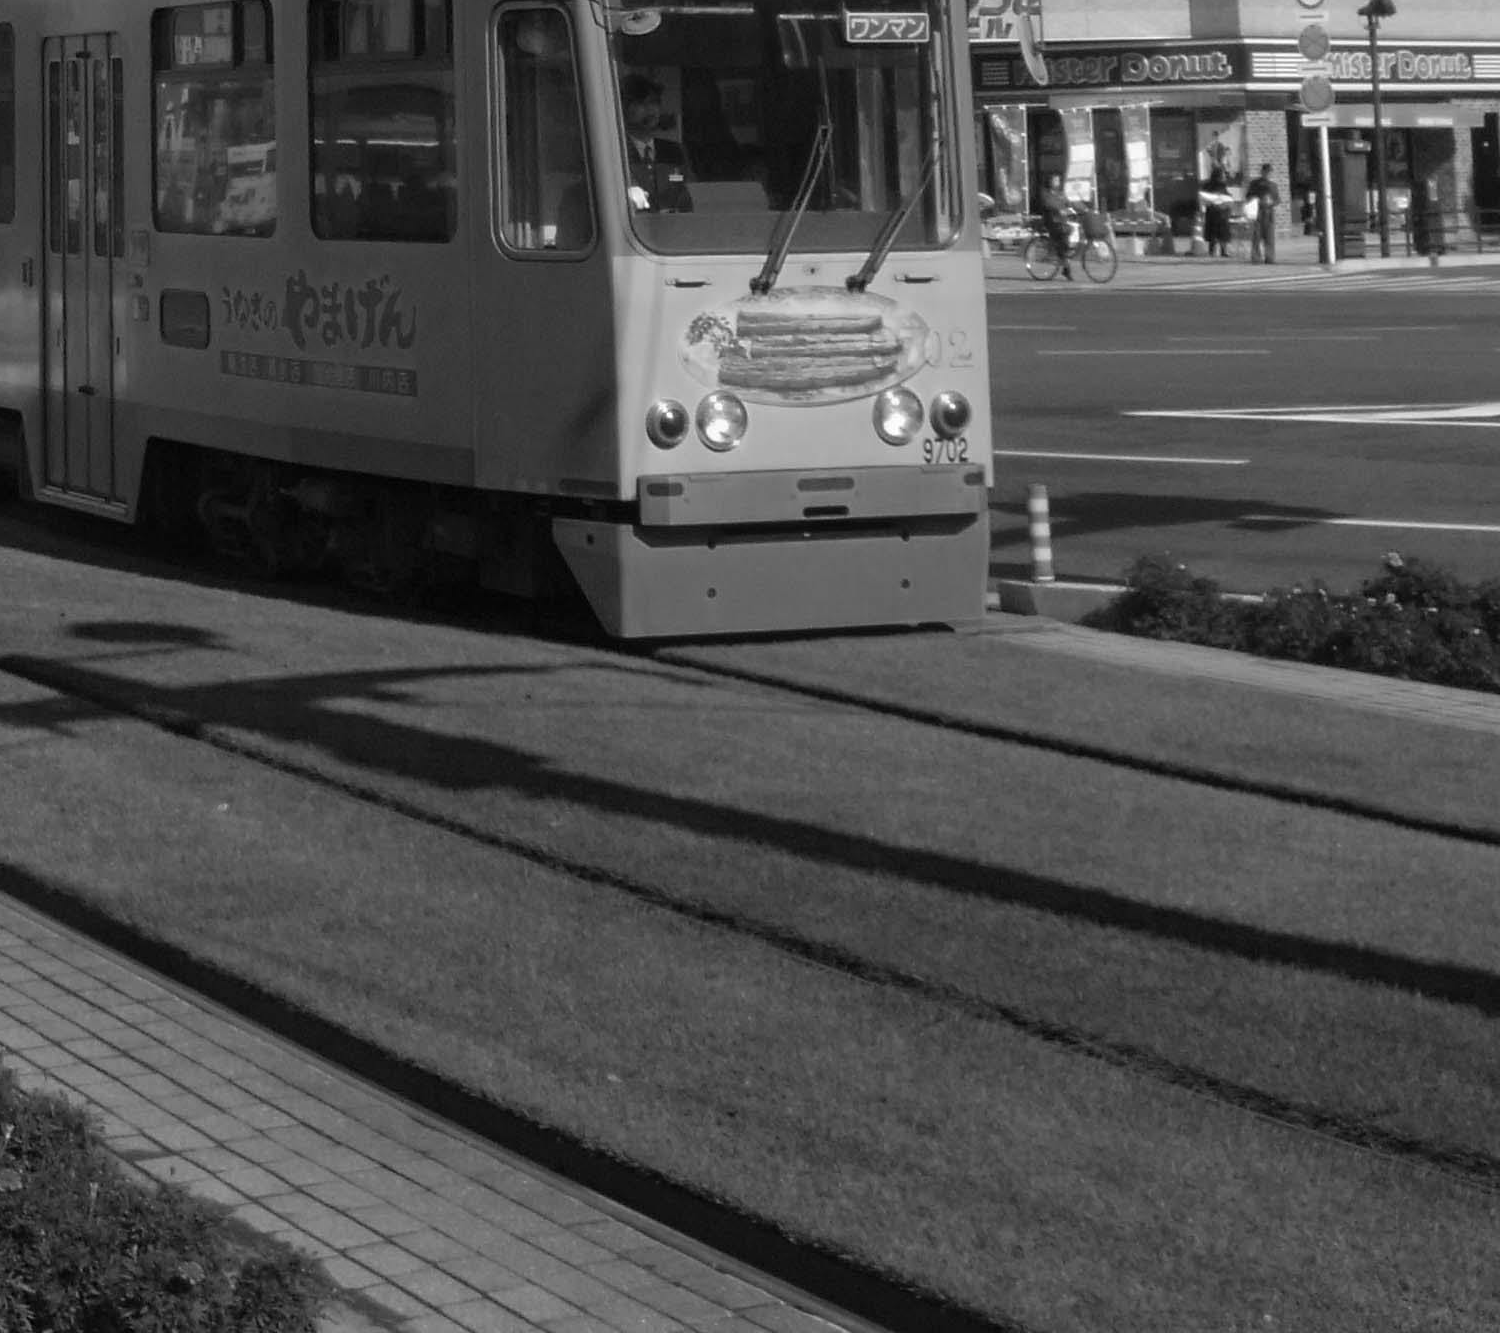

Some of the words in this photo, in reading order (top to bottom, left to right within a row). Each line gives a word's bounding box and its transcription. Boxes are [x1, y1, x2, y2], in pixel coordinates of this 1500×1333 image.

[849, 19, 926, 39] ワンマン
[1012, 55, 1118, 84] Mster
[1121, 51, 1232, 83] Donut
[1397, 49, 1472, 80] Donut
[923, 437, 969, 465] 9702
